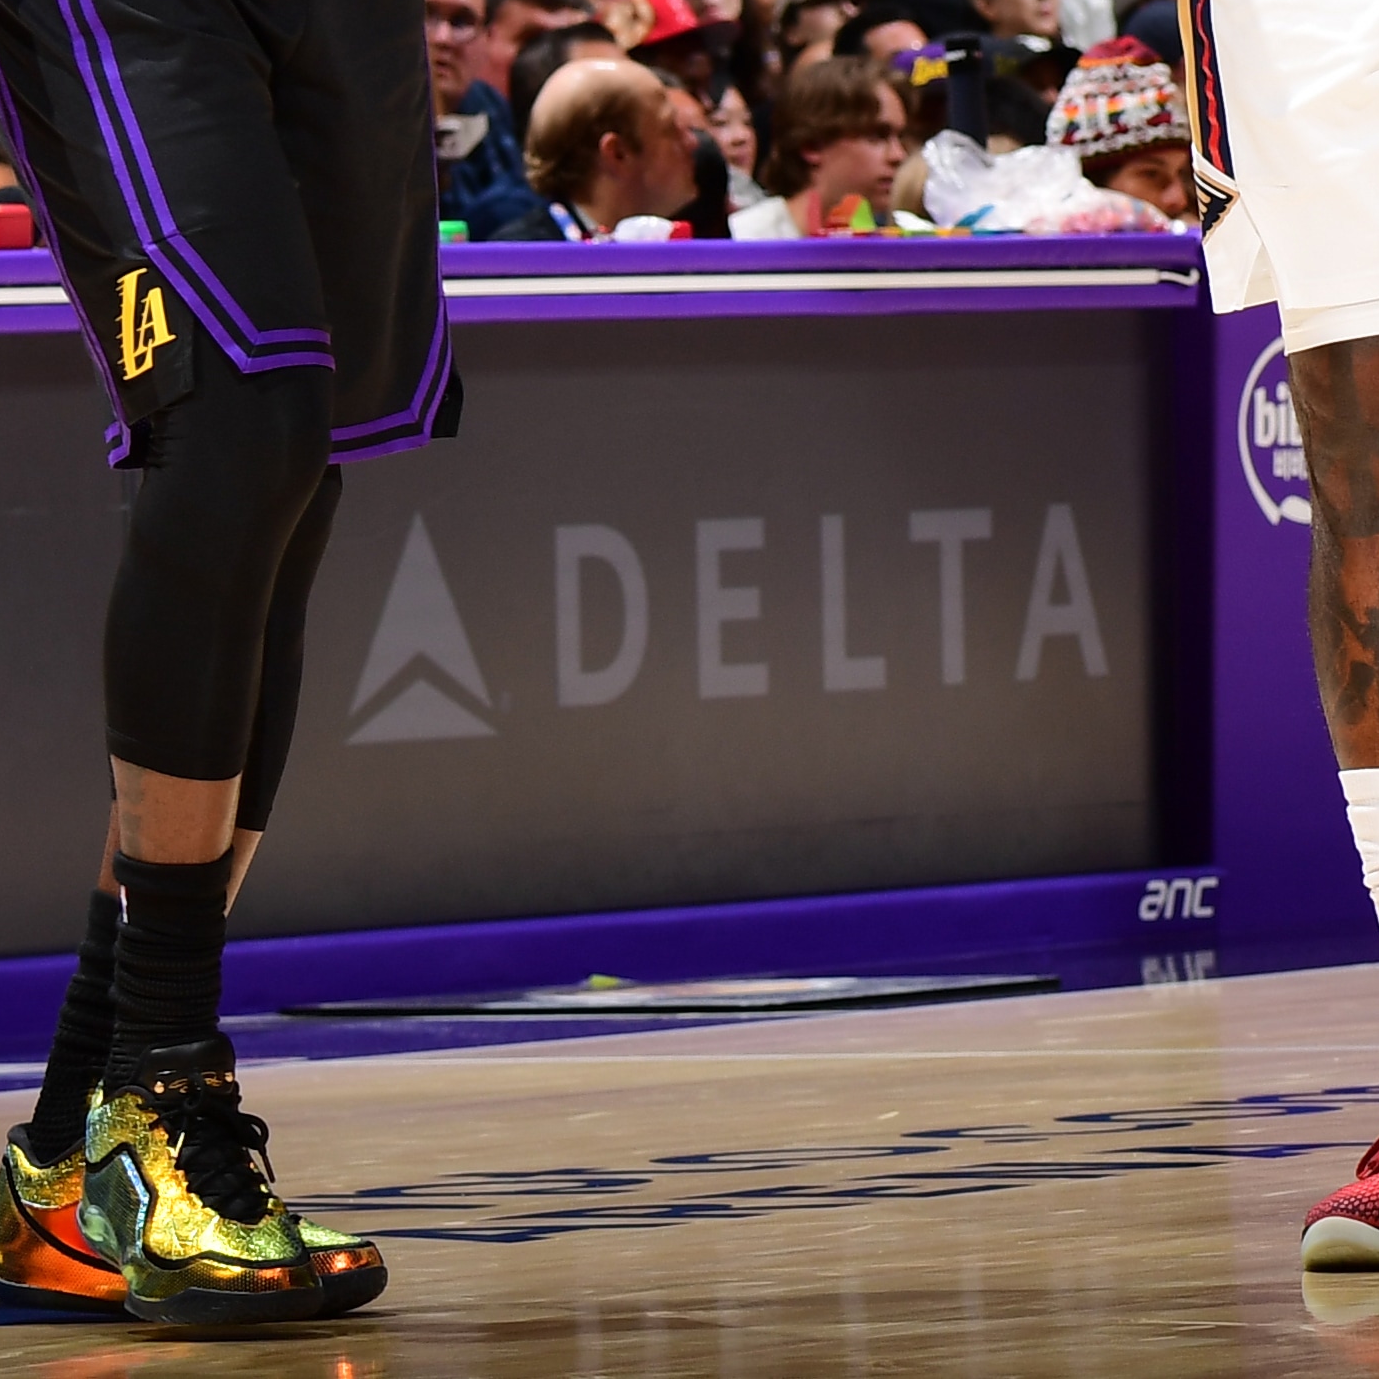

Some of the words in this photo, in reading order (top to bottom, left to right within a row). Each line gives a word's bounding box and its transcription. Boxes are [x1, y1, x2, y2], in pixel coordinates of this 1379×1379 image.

[114, 267, 177, 381] LA
[556, 503, 1109, 709] DELTA
[1138, 876, 1219, 921] anc
